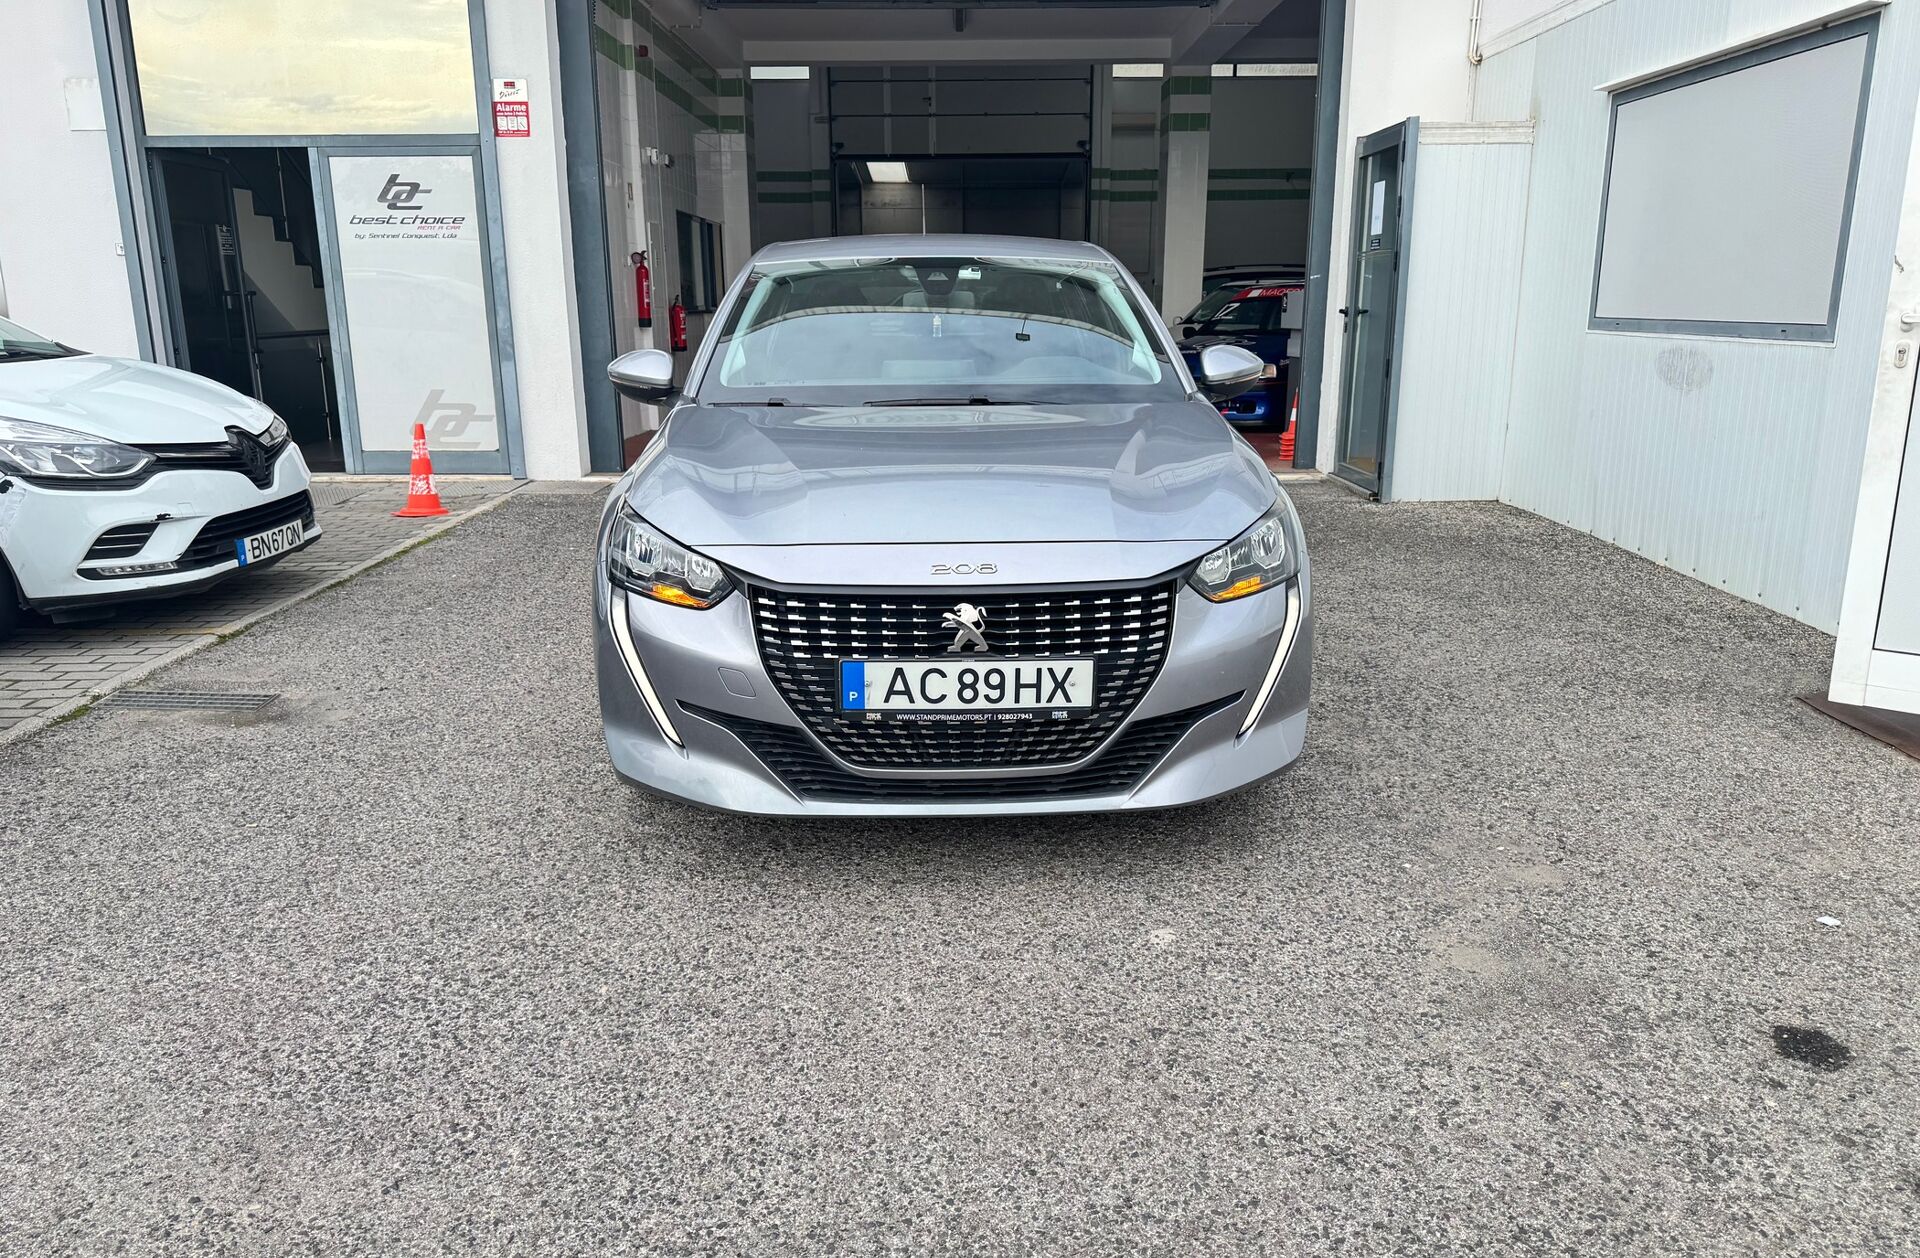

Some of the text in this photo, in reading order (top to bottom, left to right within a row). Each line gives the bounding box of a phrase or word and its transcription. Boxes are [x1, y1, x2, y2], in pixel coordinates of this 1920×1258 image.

[496, 103, 527, 112] Alarme
[349, 214, 466, 225] best choice
[930, 563, 998, 576] 208
[849, 691, 858, 702] P
[896, 713, 992, 721] WWW.STANDPRIMEMOTORS.PT
